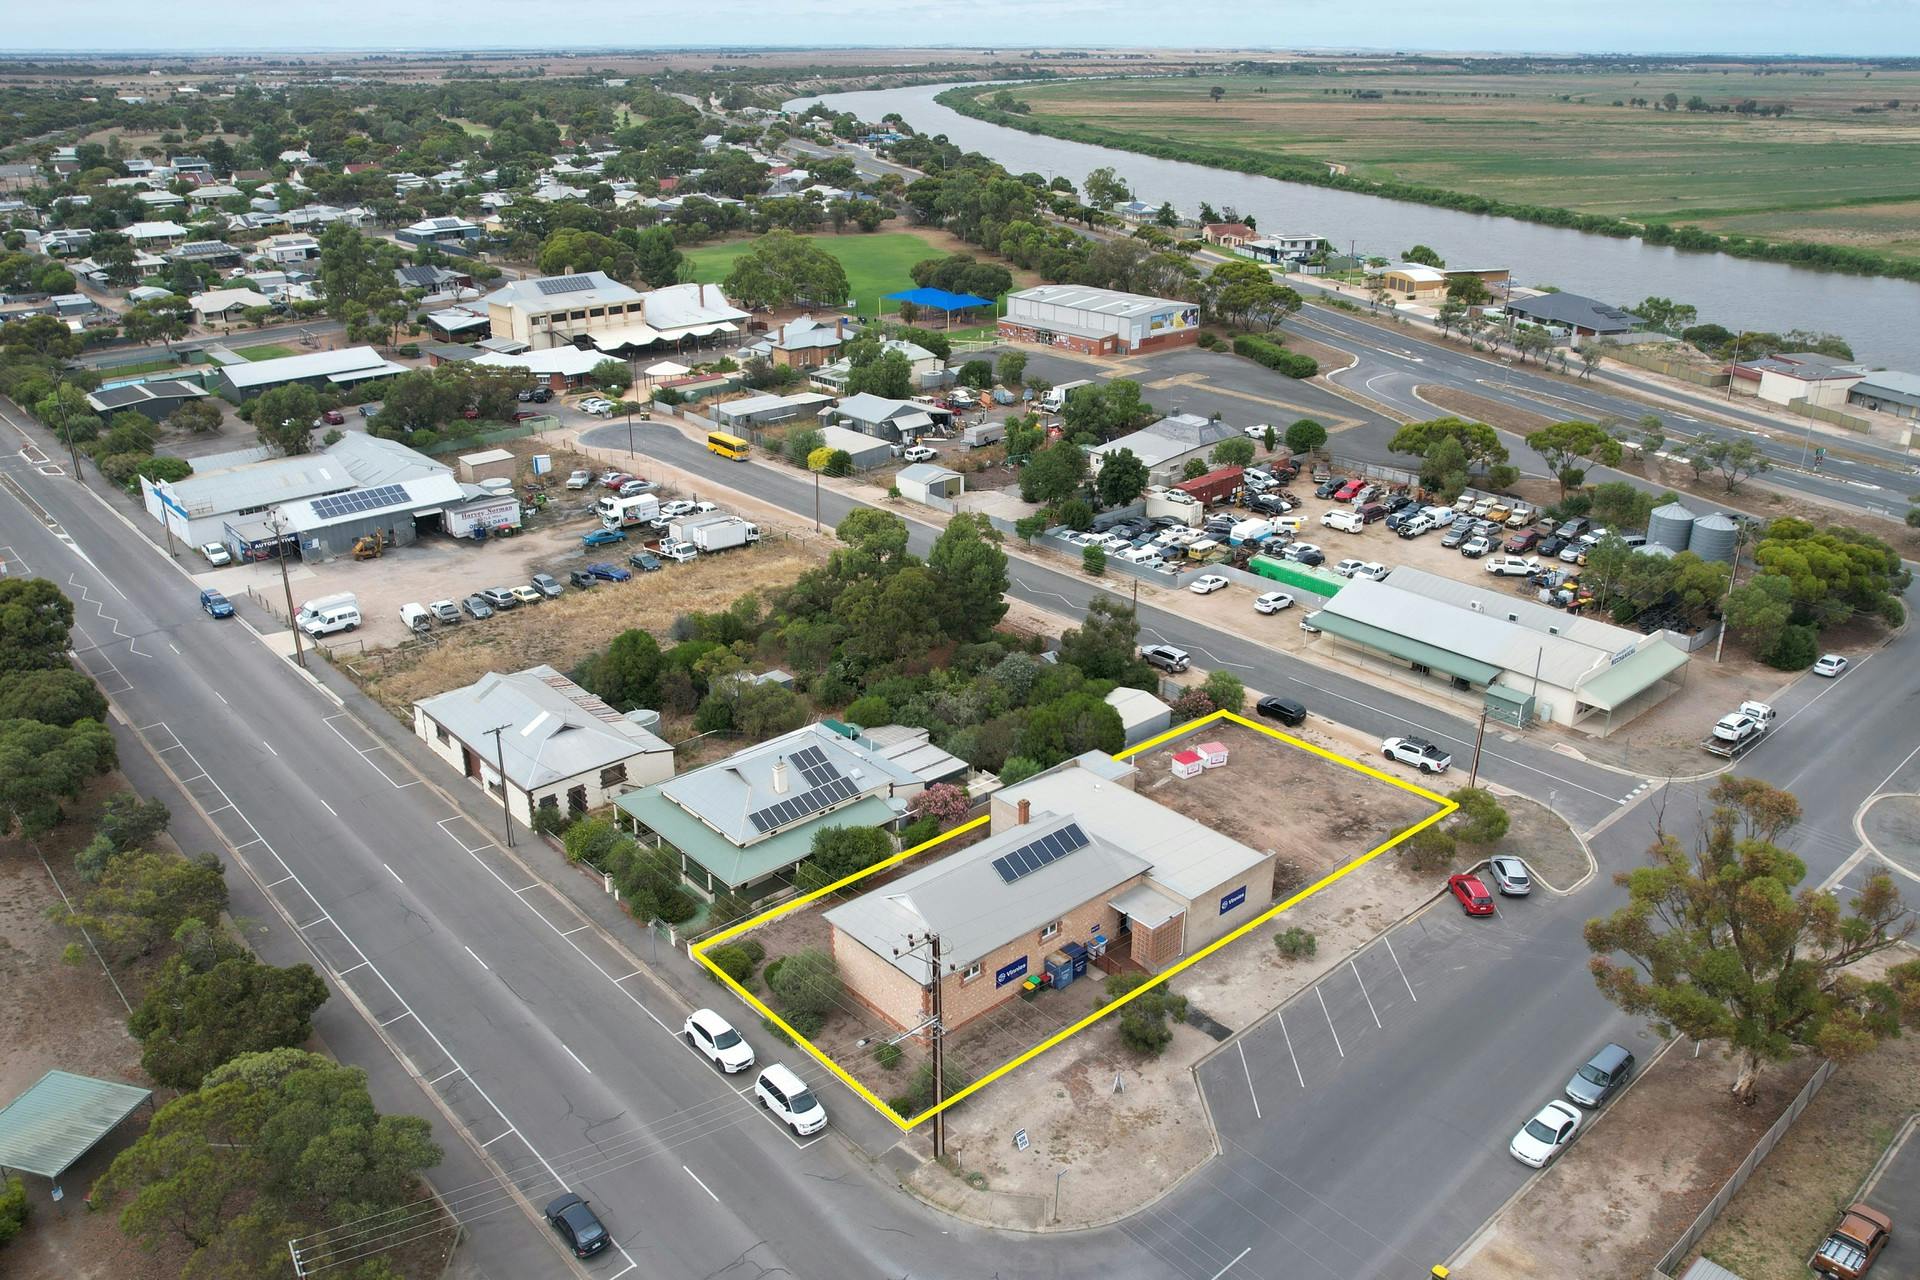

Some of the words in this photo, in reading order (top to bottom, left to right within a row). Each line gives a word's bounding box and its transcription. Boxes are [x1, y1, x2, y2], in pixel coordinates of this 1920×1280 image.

[461, 511, 484, 520] Harvey
[485, 505, 513, 515] Norman
[492, 517, 508, 525] DAYS
[254, 535, 296, 549] AUTOMTIVE
[1006, 963, 1026, 977] Vinnies
